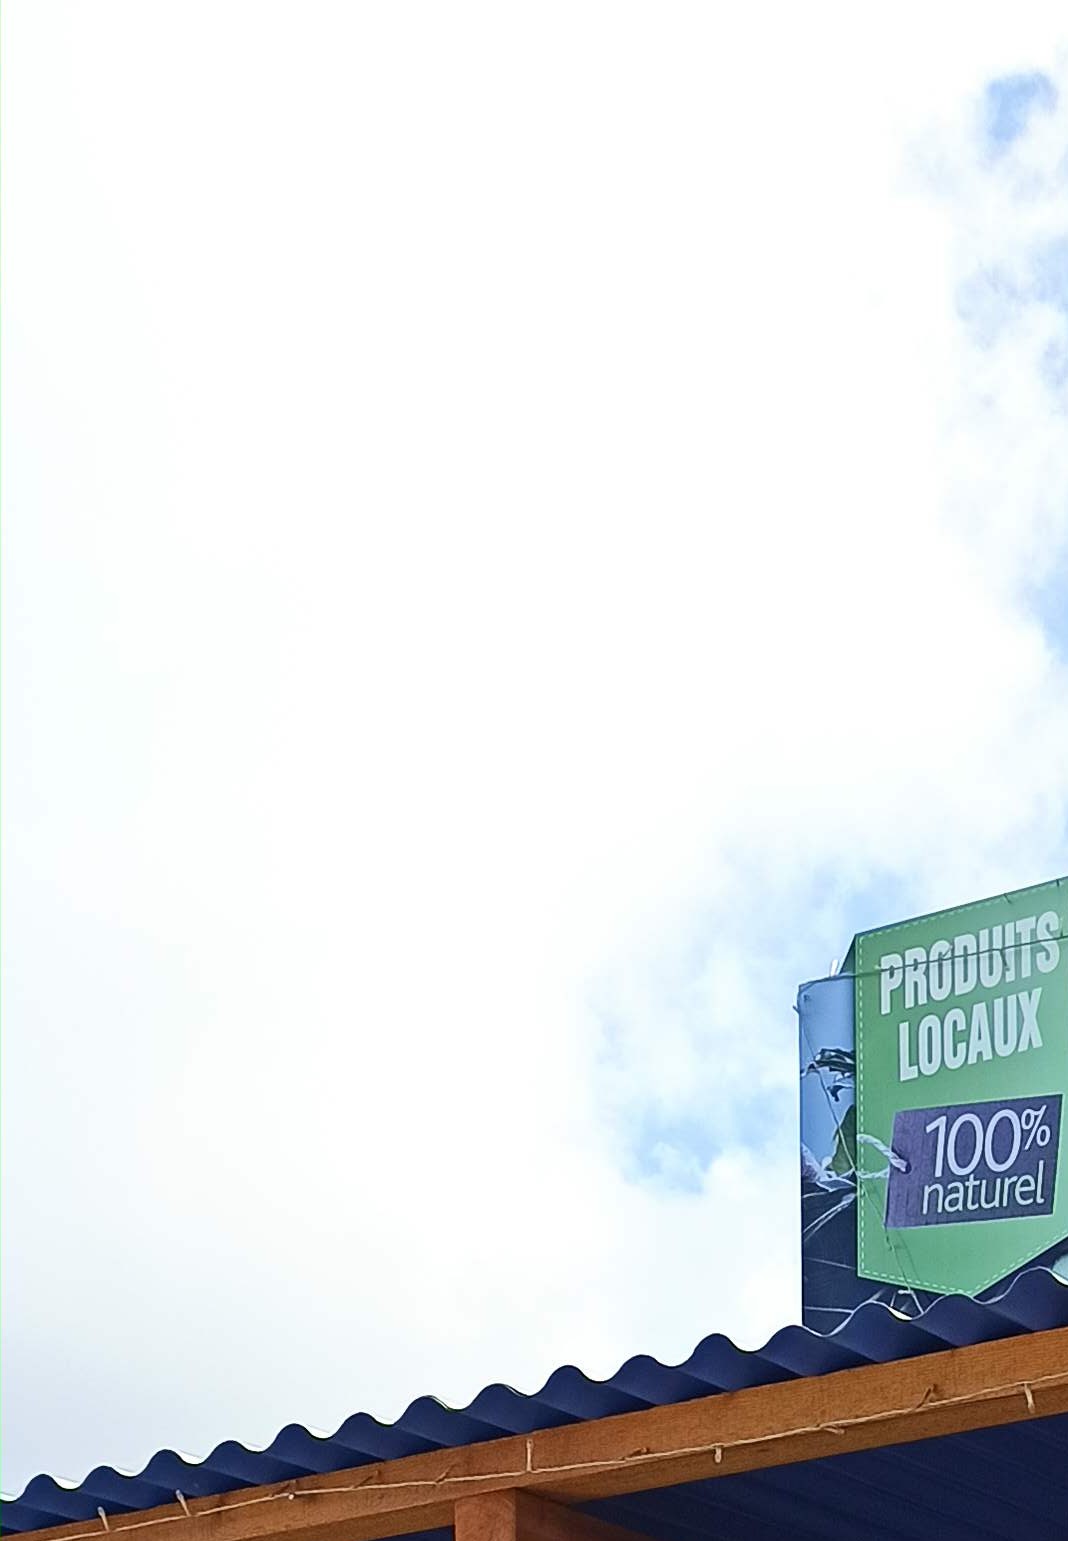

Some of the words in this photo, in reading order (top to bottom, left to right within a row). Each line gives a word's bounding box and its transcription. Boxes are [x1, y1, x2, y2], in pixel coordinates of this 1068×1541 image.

[880, 910, 1061, 1016] PRODUITS
[898, 987, 1043, 1082] LOCAUX
[925, 1104, 1051, 1178] 100%
[922, 1160, 1045, 1216] naturel
